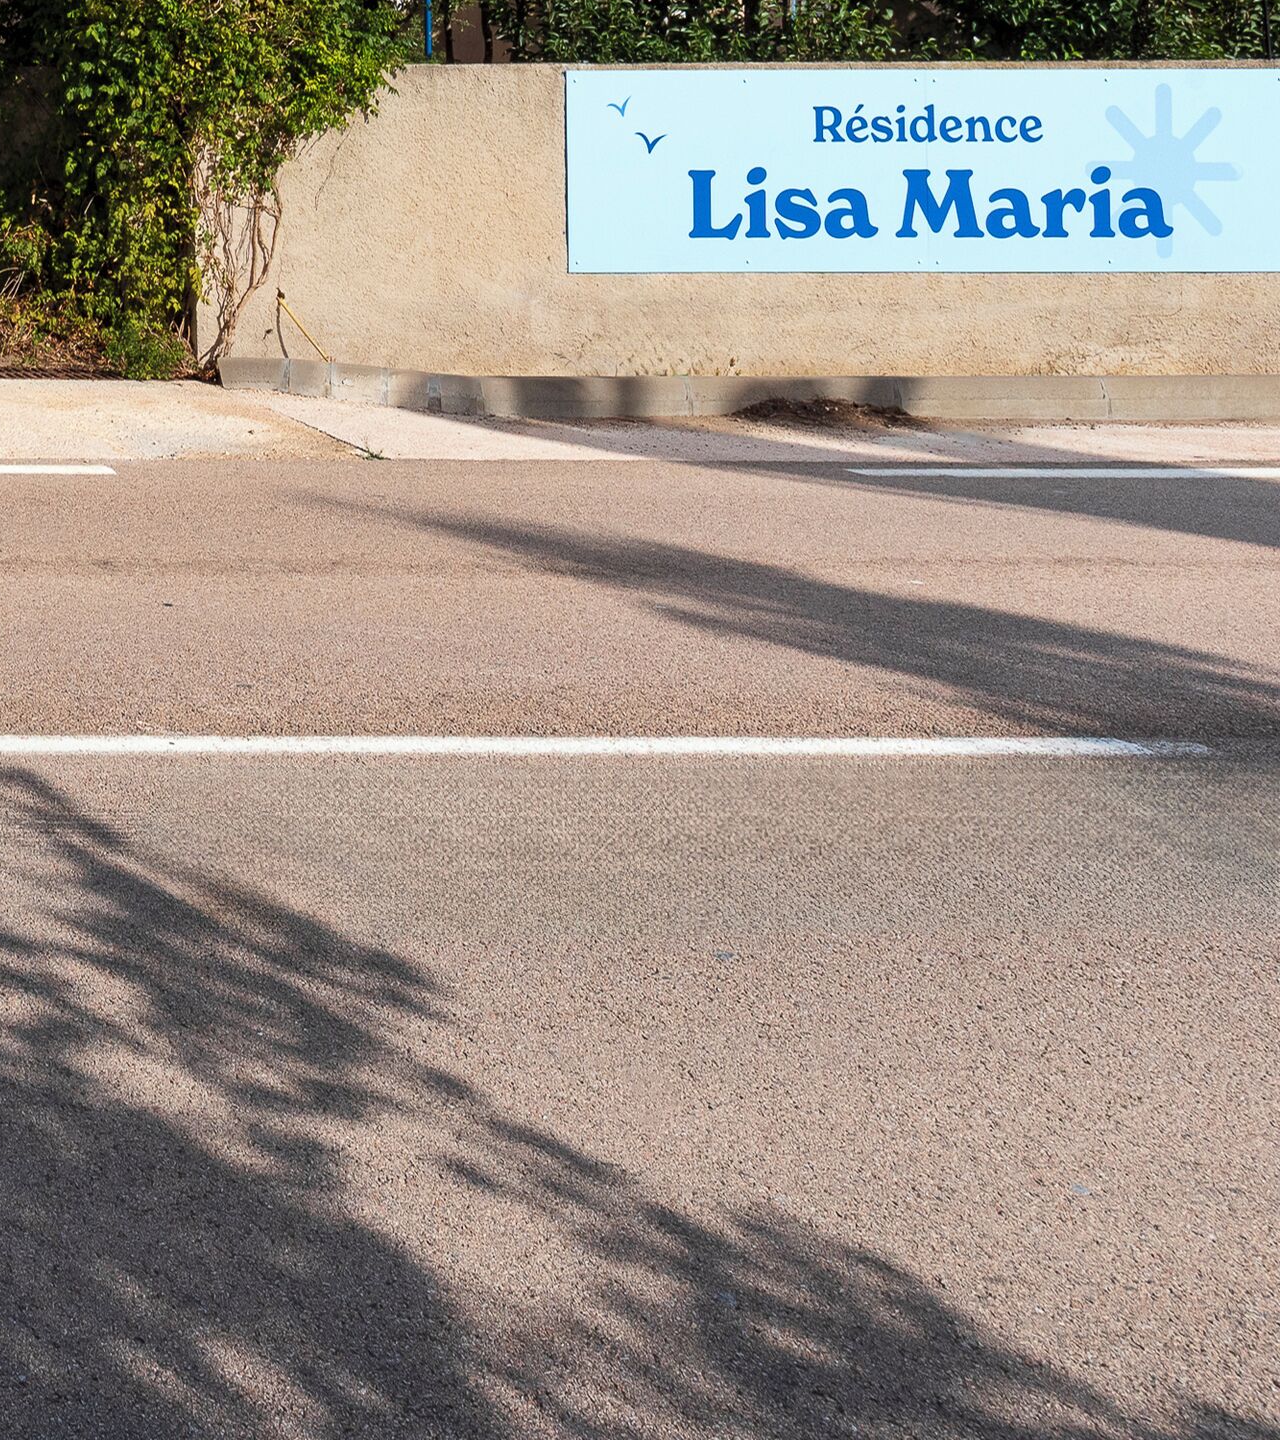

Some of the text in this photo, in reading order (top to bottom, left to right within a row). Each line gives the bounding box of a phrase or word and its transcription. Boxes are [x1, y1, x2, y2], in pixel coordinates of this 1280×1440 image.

[813, 104, 1043, 143] Résidence
[688, 166, 1173, 240] Lisa Maria
